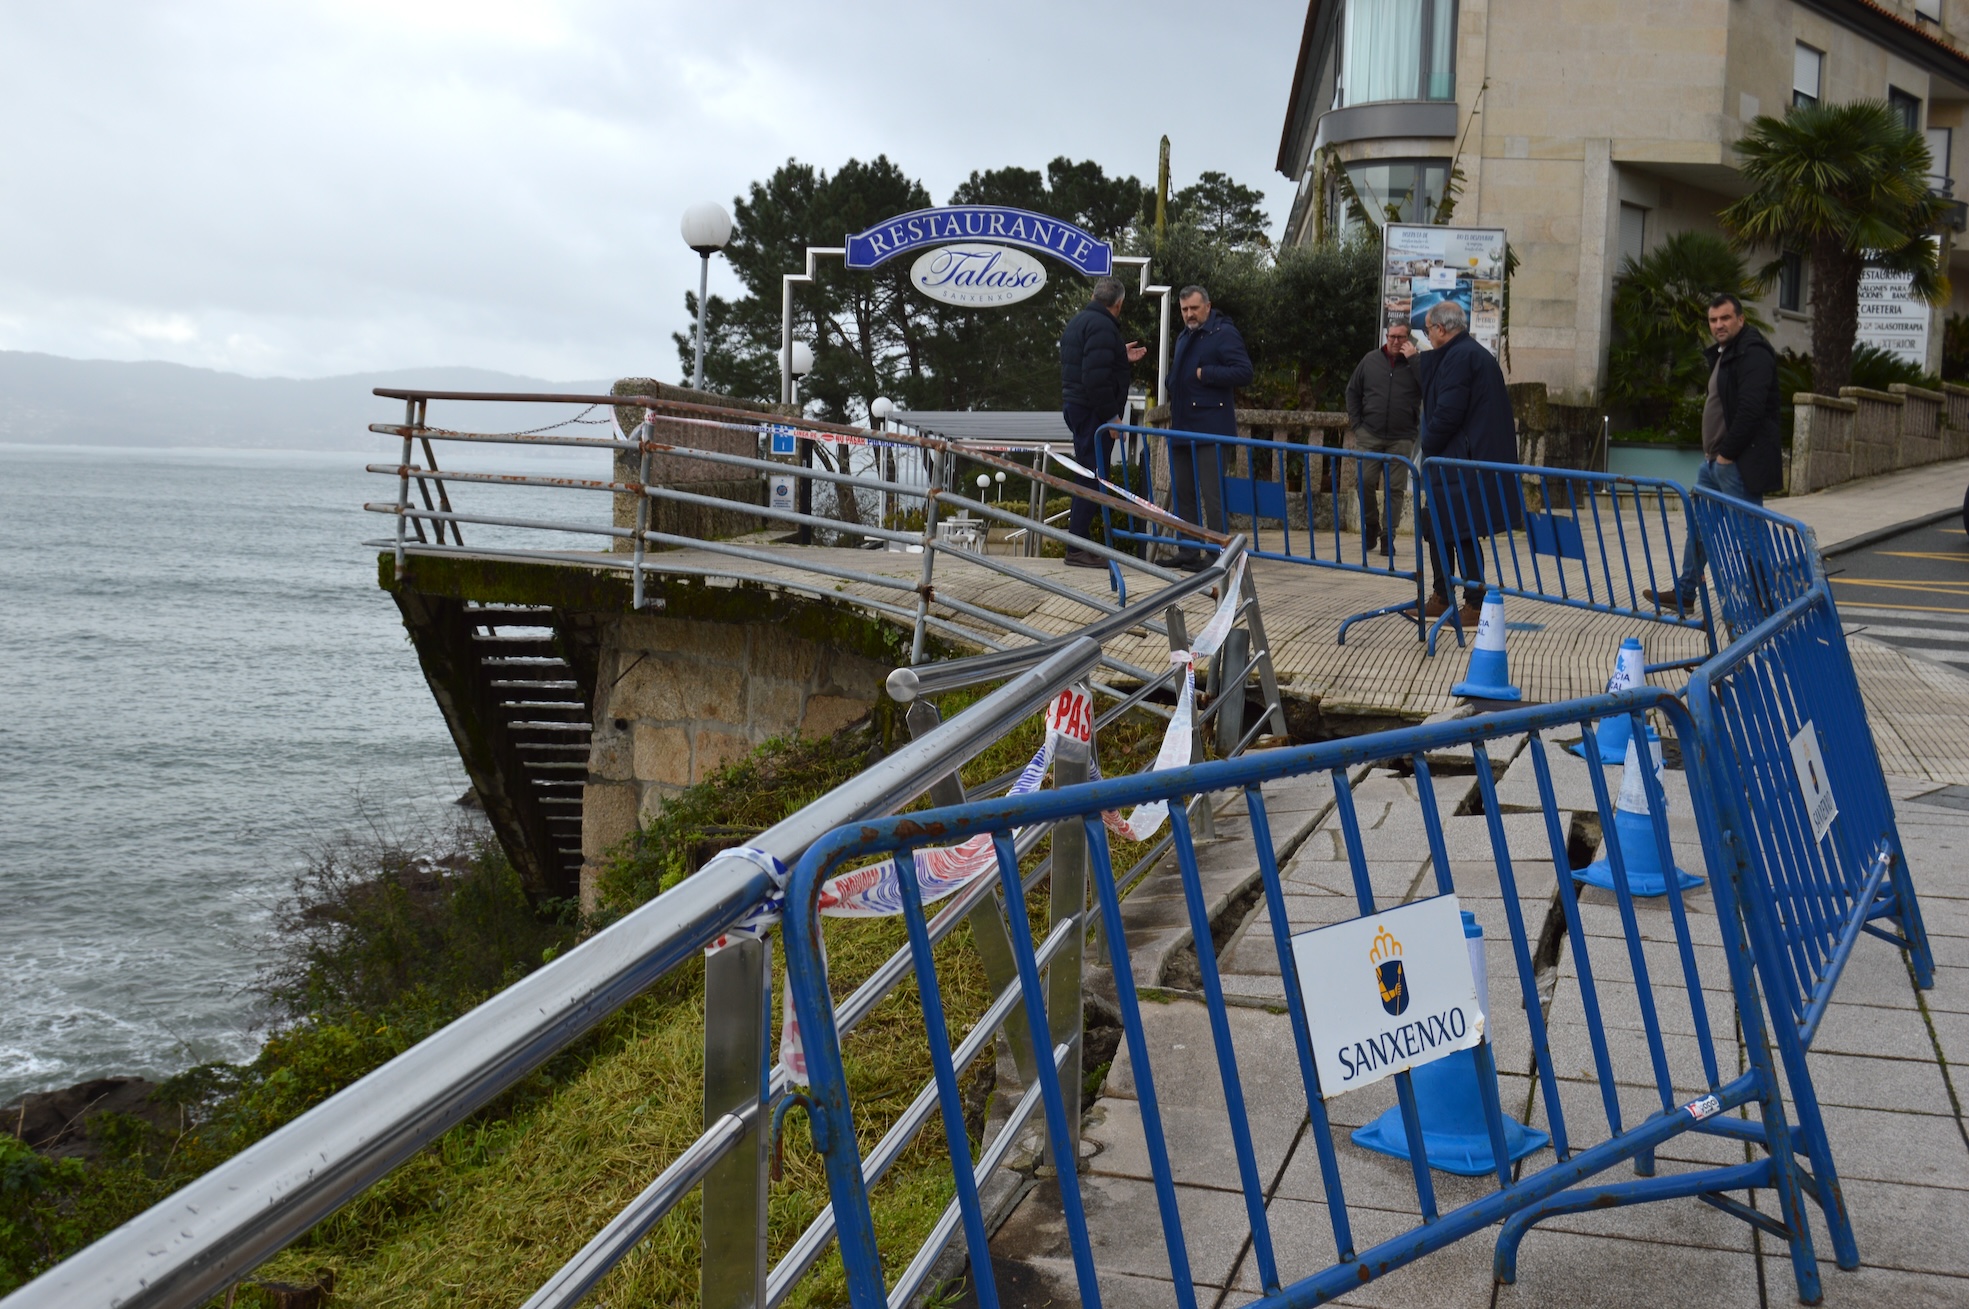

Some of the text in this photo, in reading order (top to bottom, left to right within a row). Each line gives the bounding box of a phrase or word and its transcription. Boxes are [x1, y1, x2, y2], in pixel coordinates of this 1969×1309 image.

[869, 213, 1093, 263] RESTAURANTE
[921, 248, 1042, 288] Talaso
[1861, 270, 1911, 280] ESTAURANTE
[943, 290, 1013, 301] SANXENXO
[1861, 304, 1902, 314] CAFETERIA
[835, 434, 844, 443] NO
[1053, 688, 1091, 742] PAS
[1338, 1007, 1466, 1081] SANXENXO
